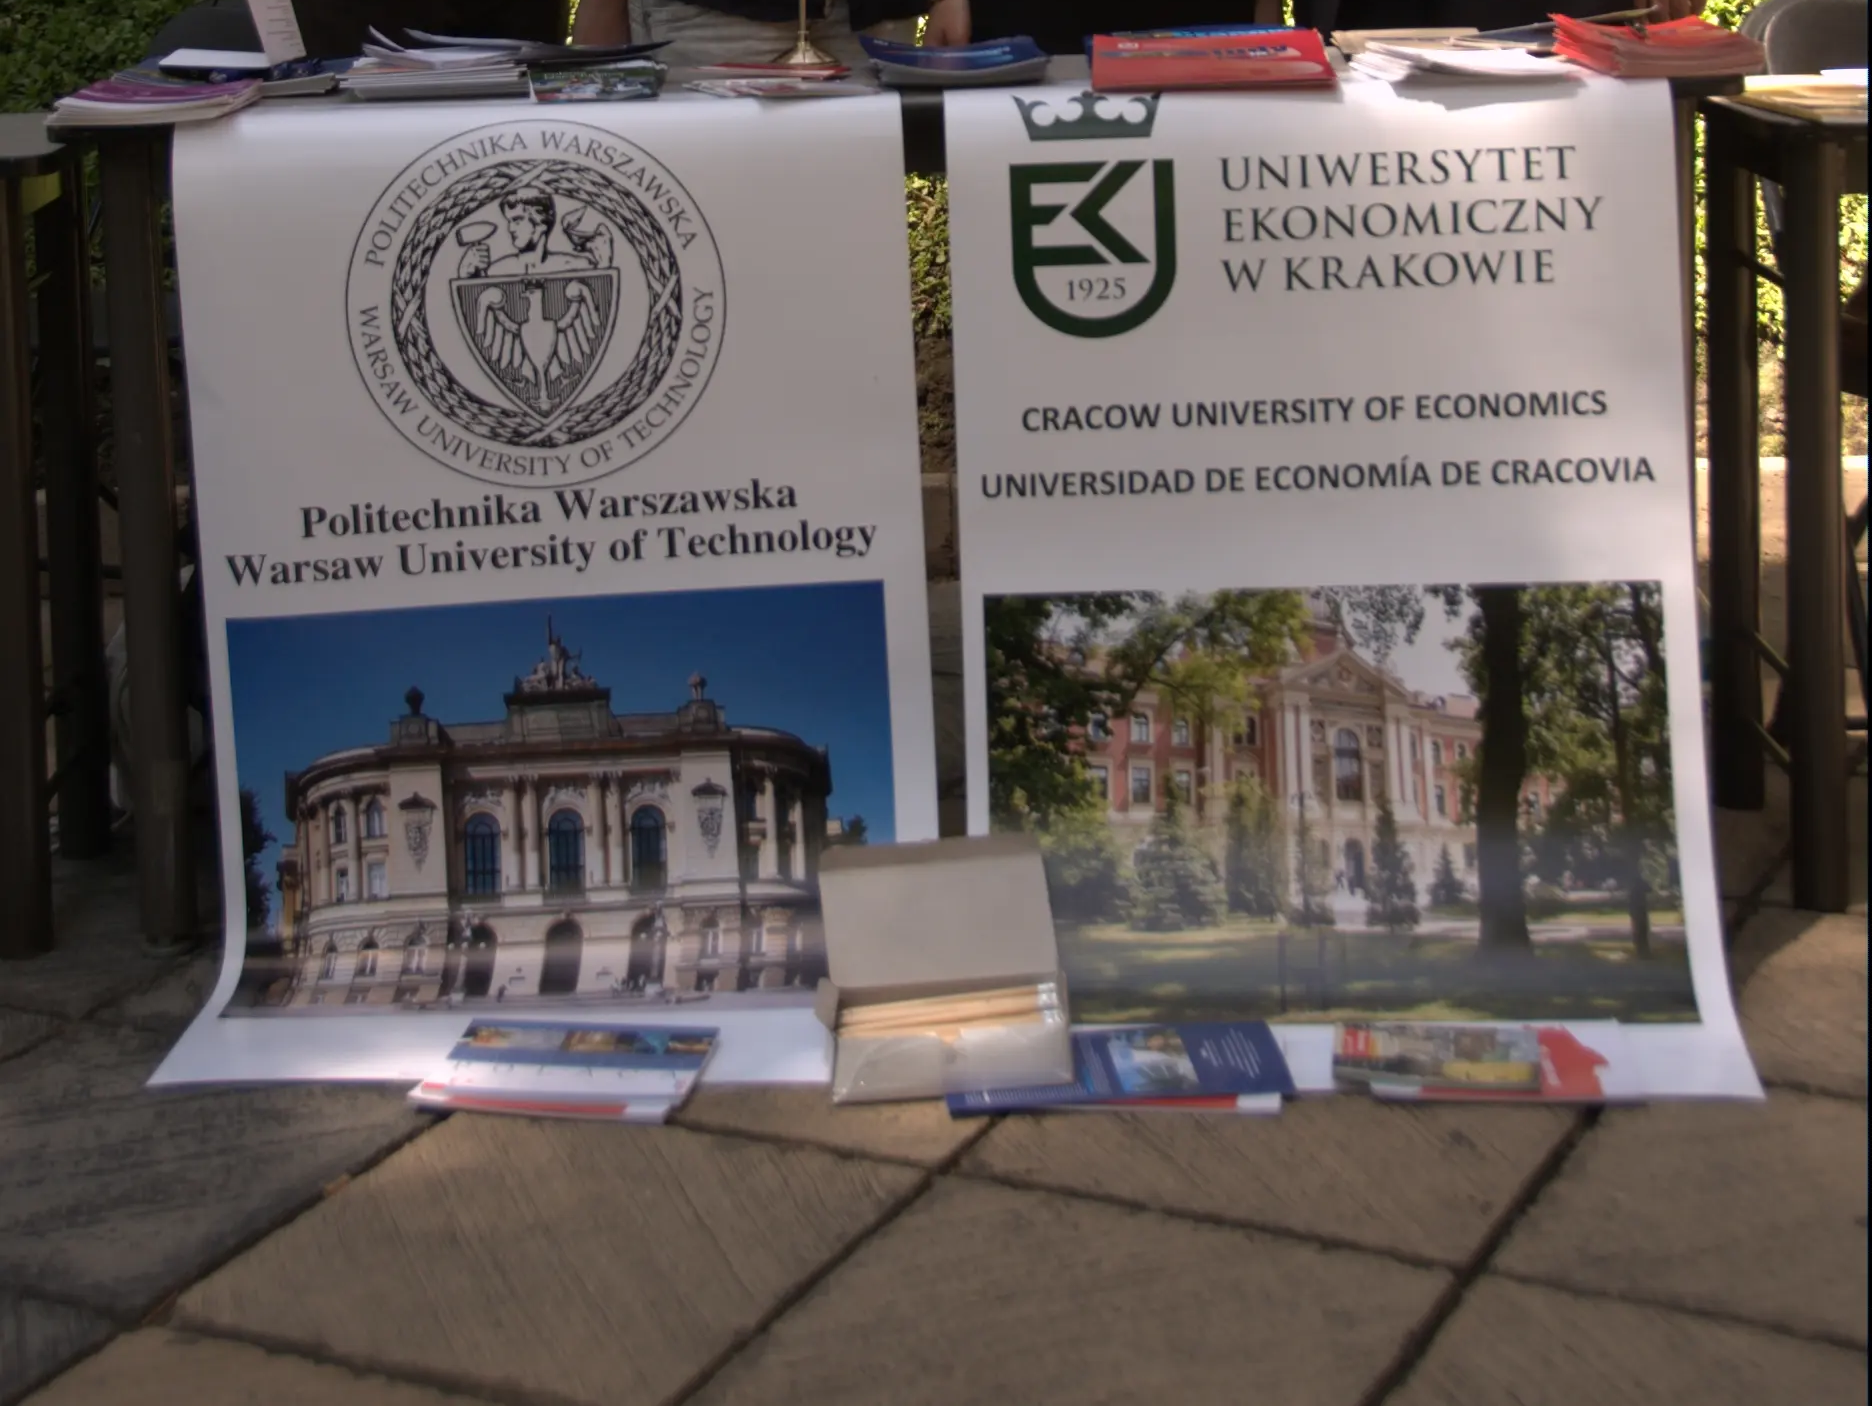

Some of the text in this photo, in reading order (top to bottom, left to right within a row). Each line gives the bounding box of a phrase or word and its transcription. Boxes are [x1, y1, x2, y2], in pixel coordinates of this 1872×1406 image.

[1218, 145, 1576, 192] UNIWERSYTET
[365, 130, 698, 267] POLITECHNIKA WARSZAWSKA
[1222, 195, 1603, 243] EKONOMICZNY
[1067, 276, 1128, 301] 1925
[1221, 249, 1555, 292] W KRAKOWIE
[359, 286, 714, 476] WARSAW UNIVERSITY OF TECHNOLOGY
[1021, 389, 1607, 431] CRACOW UNIVERSITY OF ECONOMICS
[981, 456, 1655, 498] UNIVERSIDAD DE ECONOMÍA DE CRACOVIA
[300, 478, 798, 538] Politechnika Warszawska
[225, 519, 876, 586] Warsaw University of Technology
